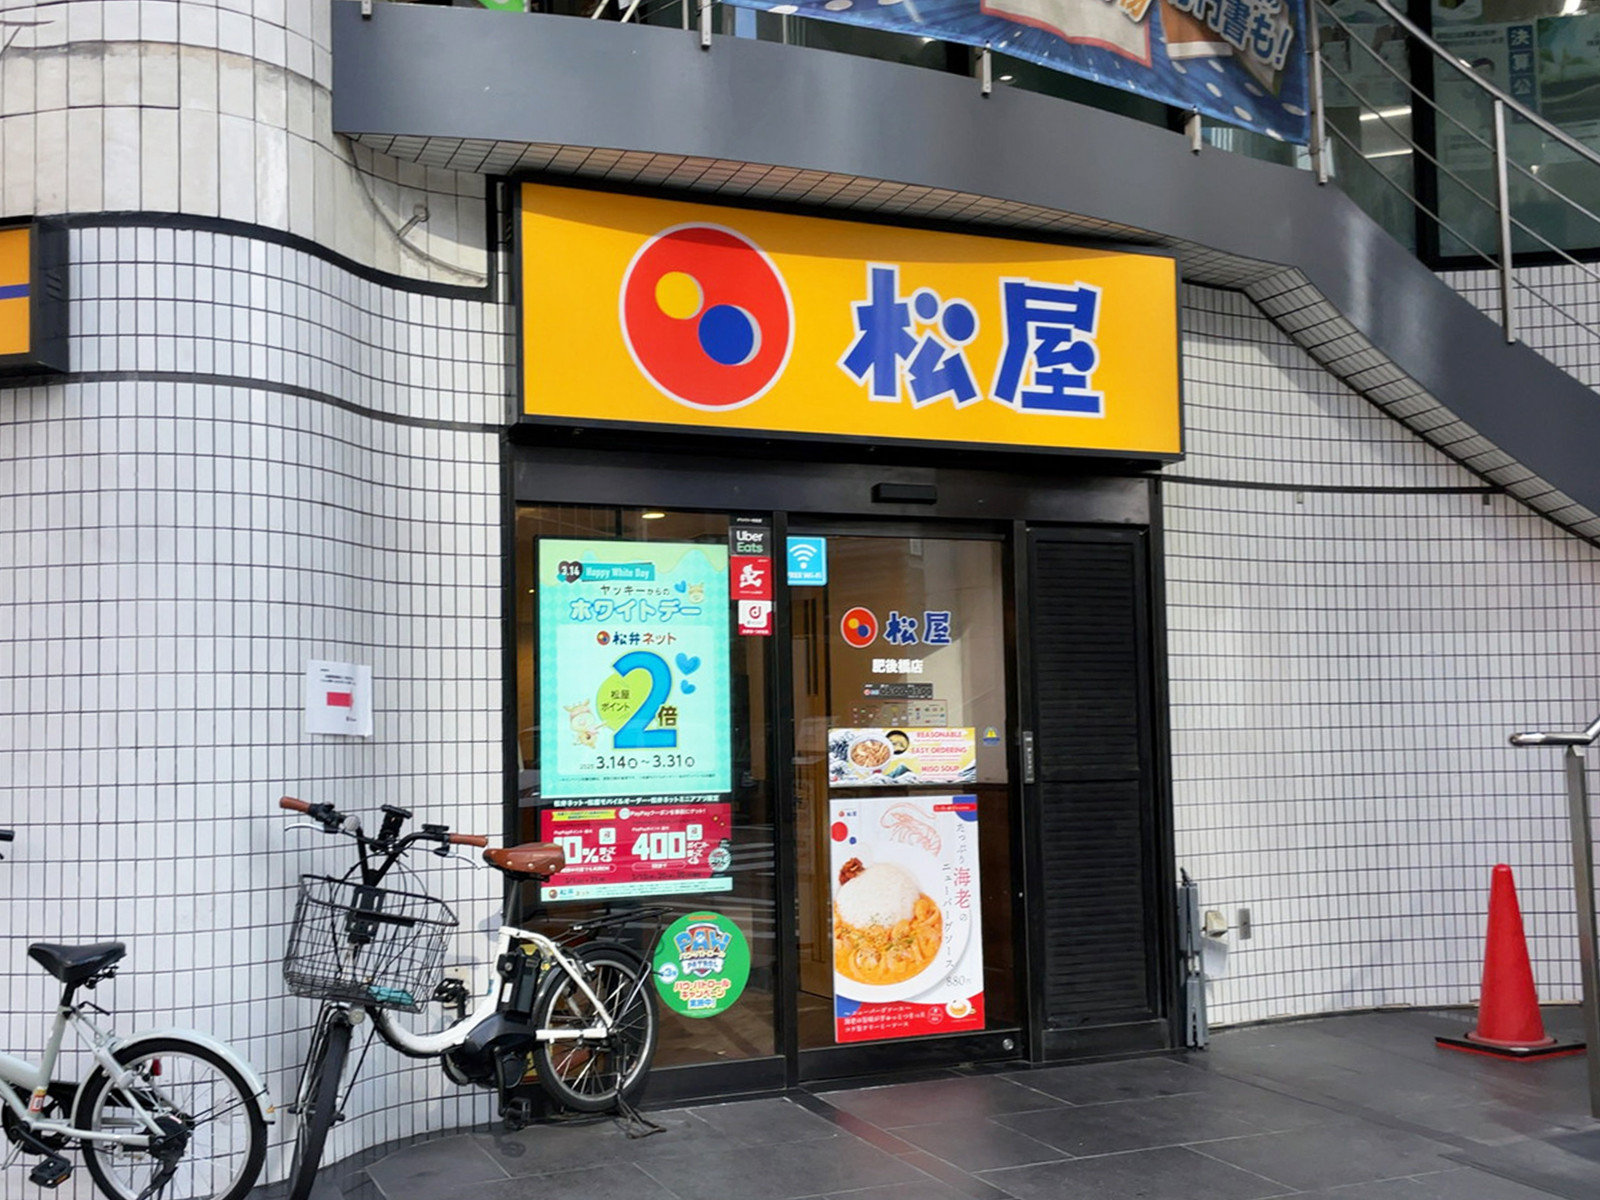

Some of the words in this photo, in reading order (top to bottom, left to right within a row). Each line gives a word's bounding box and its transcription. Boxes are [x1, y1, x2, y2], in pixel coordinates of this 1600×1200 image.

[1511, 29, 1531, 118] 決算公
[837, 262, 1105, 418] 松屋
[736, 530, 763, 541] Uber
[737, 542, 763, 553] Eats
[586, 567, 610, 579] Happy
[612, 567, 634, 577] White
[635, 568, 650, 579] Day
[570, 598, 702, 622] ホワイトデー
[883, 611, 952, 646] 松屋
[601, 703, 631, 712] ポイント
[612, 650, 677, 749] 2
[658, 705, 678, 727] 倍
[631, 831, 686, 861] 400
[674, 930, 732, 953] PAW
